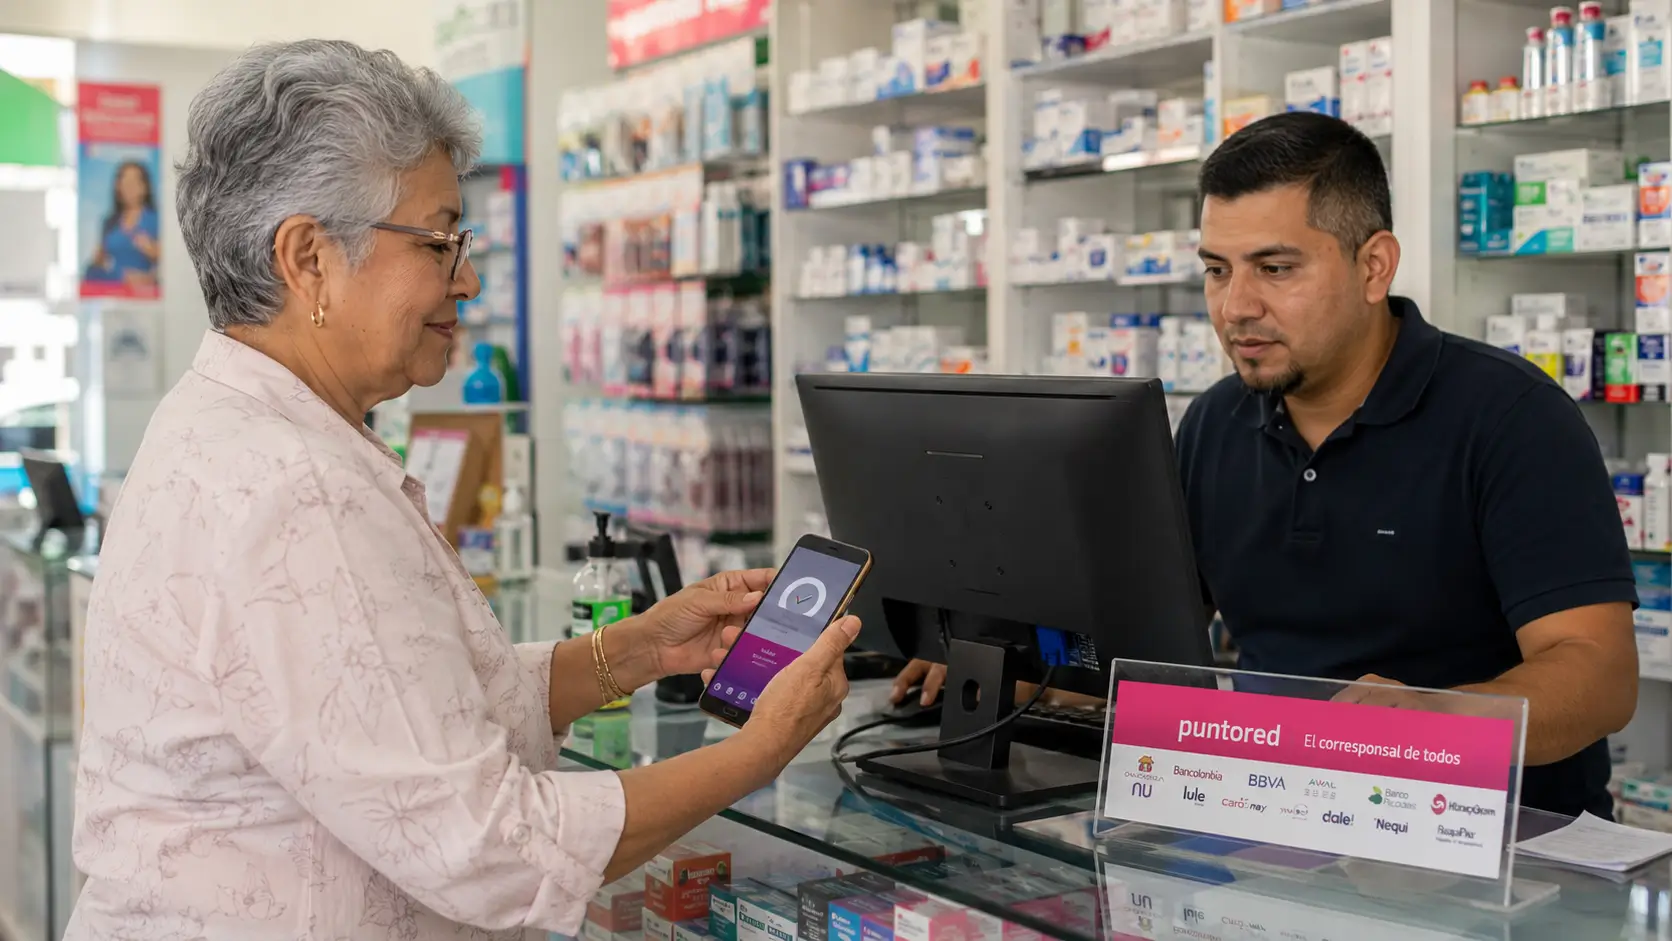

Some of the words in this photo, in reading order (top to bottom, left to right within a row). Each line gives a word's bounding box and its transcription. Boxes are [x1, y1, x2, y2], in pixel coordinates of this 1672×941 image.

[1177, 719, 1281, 747] puntored
[1304, 734, 1316, 748] El
[1319, 737, 1401, 758] corresponsal
[1404, 746, 1420, 760] de
[1423, 749, 1461, 765] todos
[1248, 773, 1286, 790] BBVA
[1322, 810, 1355, 826] dale!
